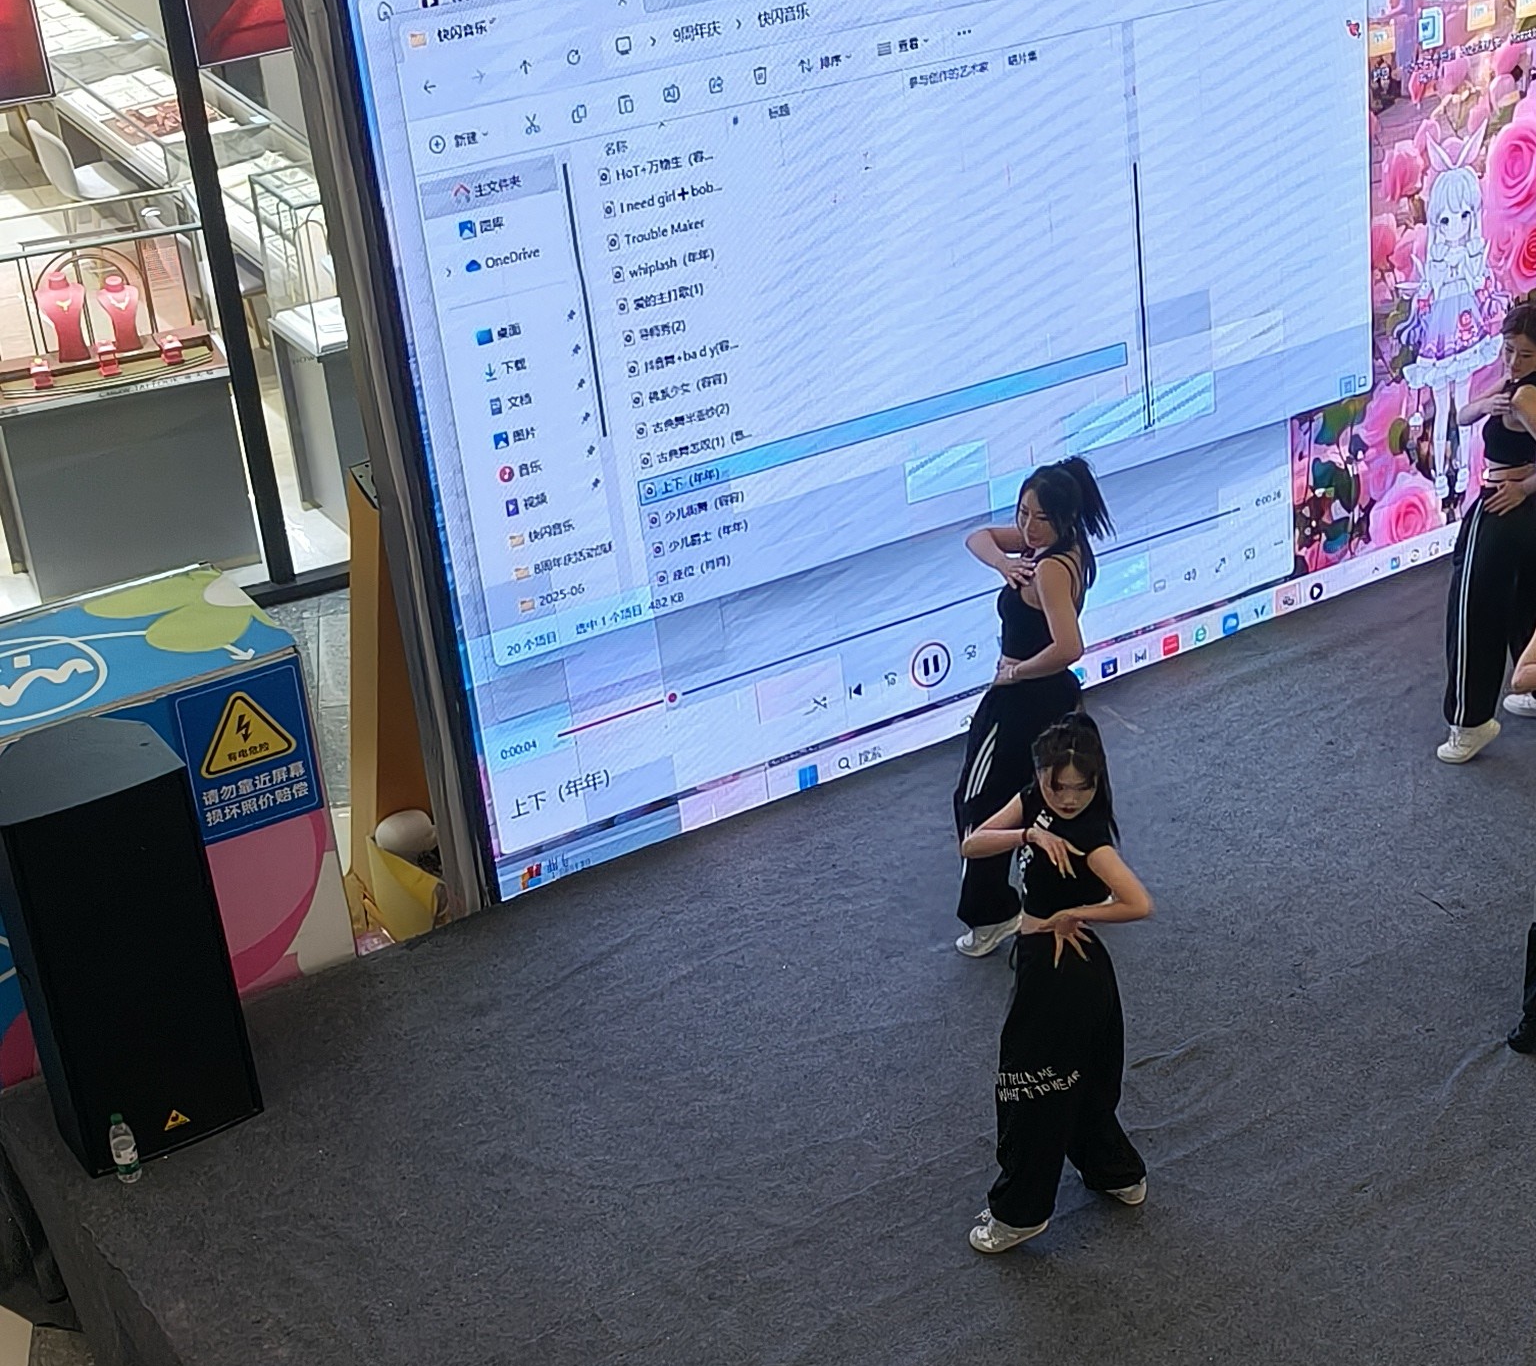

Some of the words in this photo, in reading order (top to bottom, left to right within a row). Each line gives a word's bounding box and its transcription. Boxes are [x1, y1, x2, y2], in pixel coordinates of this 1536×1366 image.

[757, 2, 811, 28] 快闪音乐
[436, 19, 488, 43] 快闪音乐
[672, 20, 722, 44] 9周年庆
[819, 53, 843, 71] 排序
[454, 131, 479, 148] 新建
[605, 140, 629, 157] 名称
[474, 175, 522, 198] 主文件夹
[626, 195, 655, 212] need
[623, 226, 669, 246] Trouble
[670, 218, 705, 234] Maker
[485, 246, 541, 270] OneDrive
[497, 323, 522, 340] 桌面
[502, 357, 528, 375] 下载
[507, 392, 533, 409] 文档
[512, 426, 537, 444] 图片
[518, 459, 543, 478] 音乐
[528, 519, 576, 543] 快闪音乐
[539, 583, 586, 607] 2025-06
[669, 591, 685, 604] KB
[507, 641, 521, 657] 20
[226, 741, 270, 762] 有电危险
[202, 760, 306, 807] 请勿靠近屏幕
[205, 781, 309, 827] 损坏照价赔偿
